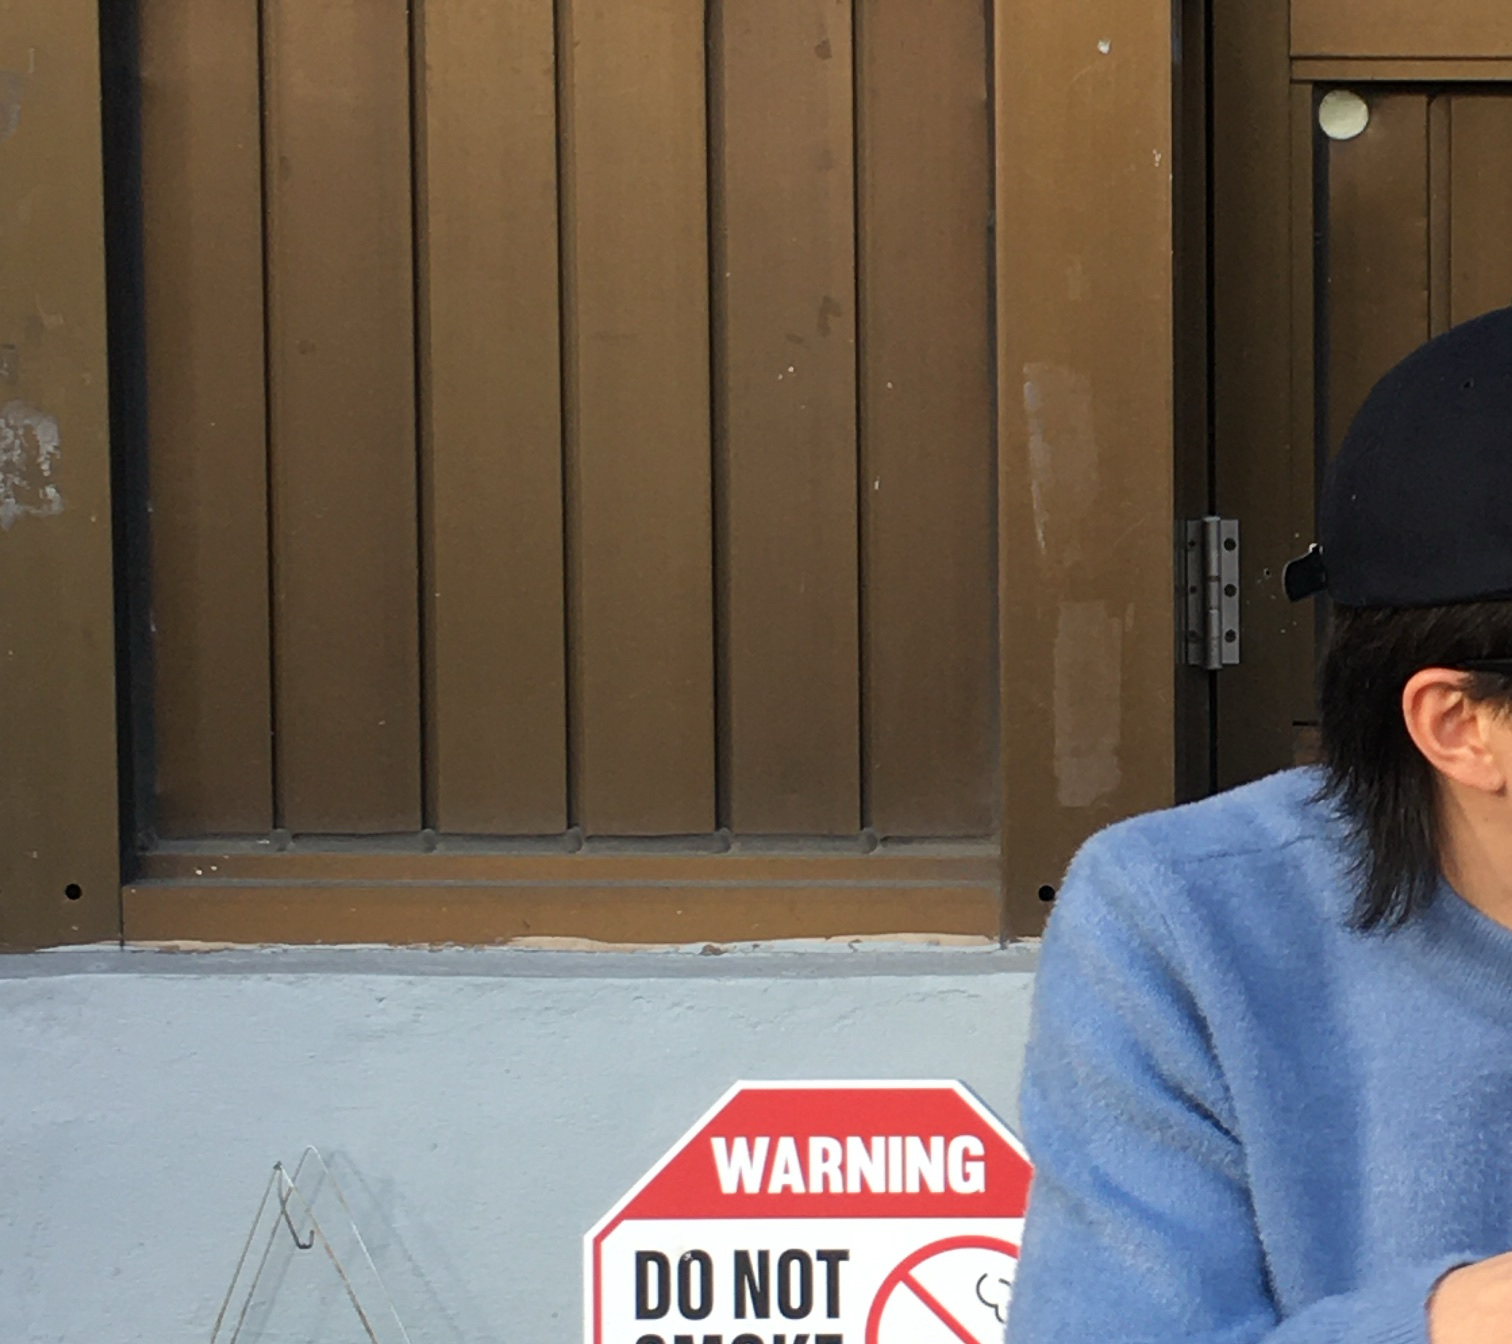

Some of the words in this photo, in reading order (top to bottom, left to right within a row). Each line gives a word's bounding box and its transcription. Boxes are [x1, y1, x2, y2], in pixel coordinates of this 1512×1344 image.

[711, 1134, 987, 1195] WARNING
[634, 1249, 714, 1321] DO
[733, 1248, 850, 1320] NOT
